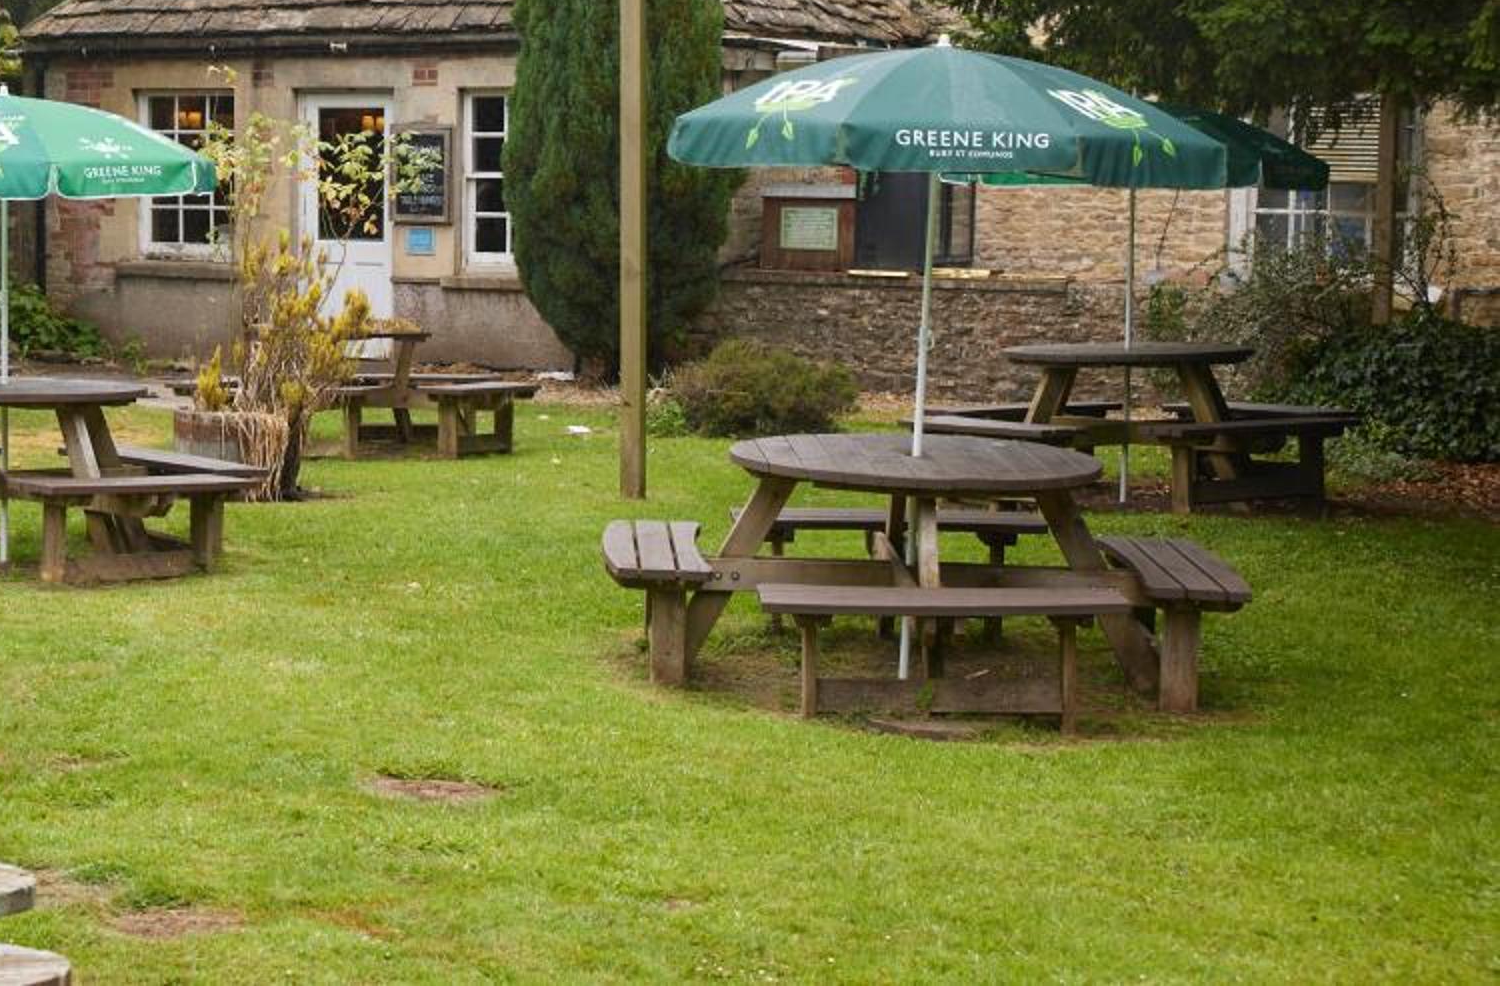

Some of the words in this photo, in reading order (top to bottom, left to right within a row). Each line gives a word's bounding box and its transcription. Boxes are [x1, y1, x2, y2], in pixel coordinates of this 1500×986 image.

[755, 79, 838, 105] IPA
[1046, 89, 1144, 120] IPA
[895, 129, 983, 147] GREENE
[993, 131, 1050, 149] KING
[83, 165, 129, 178] GREENE
[131, 165, 163, 176] KING
